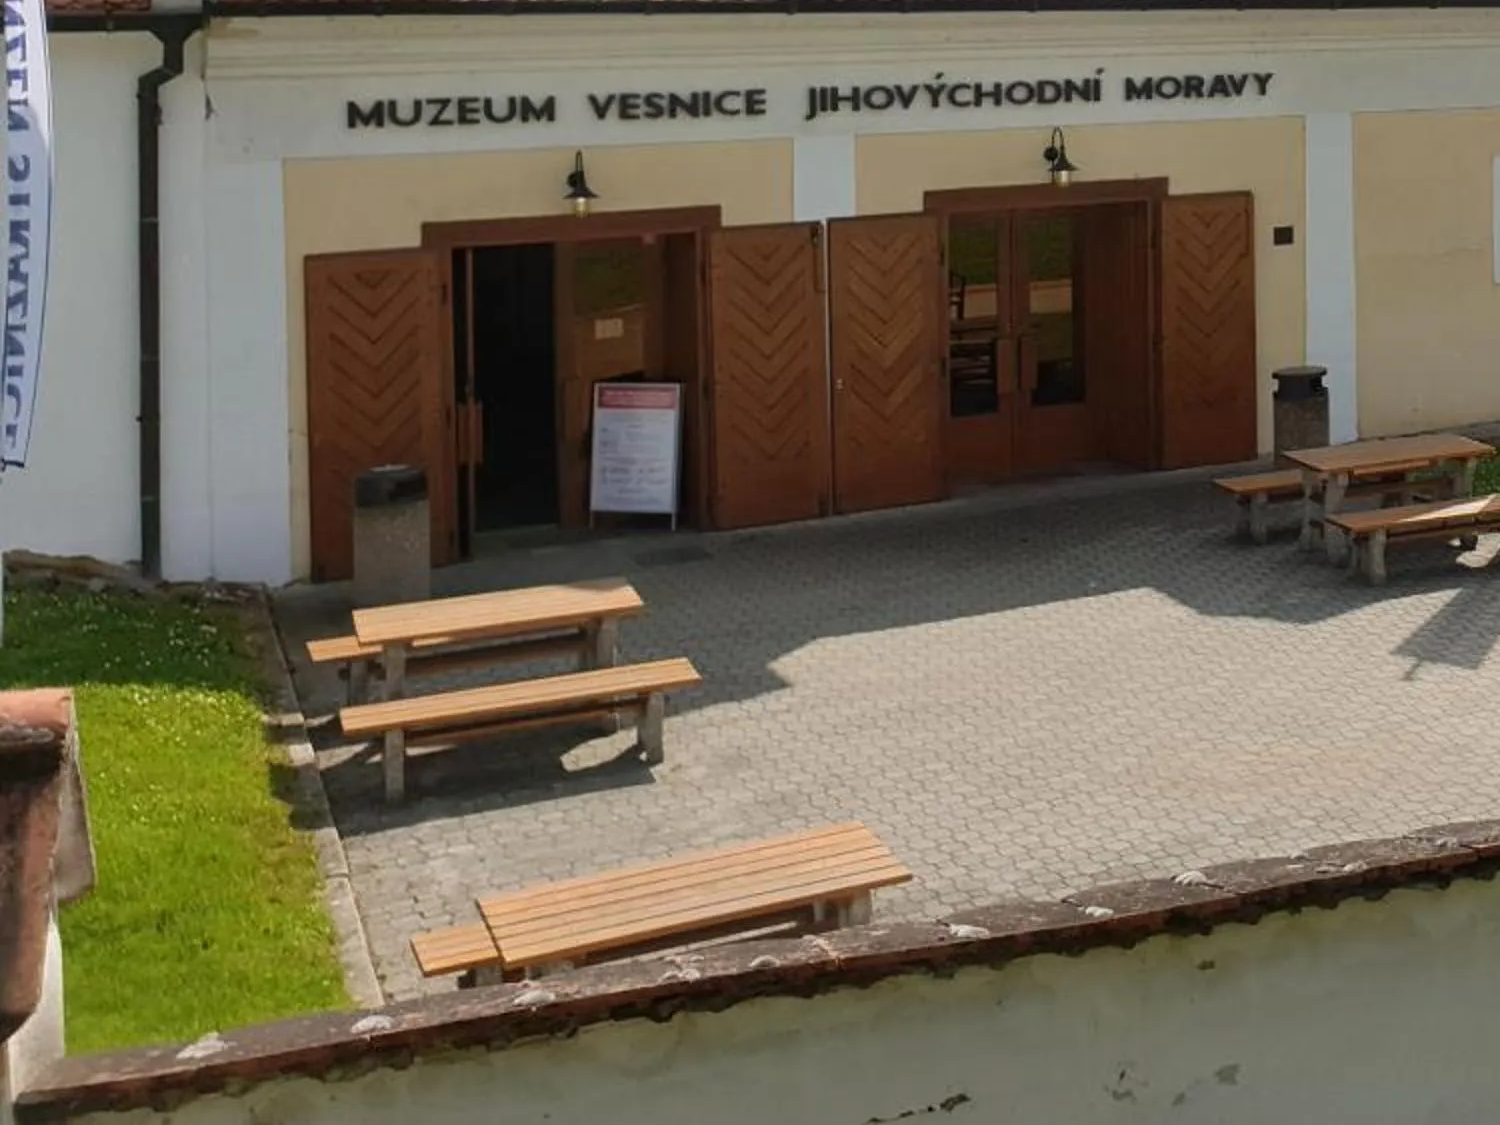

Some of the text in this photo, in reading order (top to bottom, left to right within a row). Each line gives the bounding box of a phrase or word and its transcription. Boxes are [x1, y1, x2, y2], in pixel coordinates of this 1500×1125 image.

[347, 68, 1275, 129] MUZEUM VESNICE JIHOVÝCHODNÍ MORAVY
